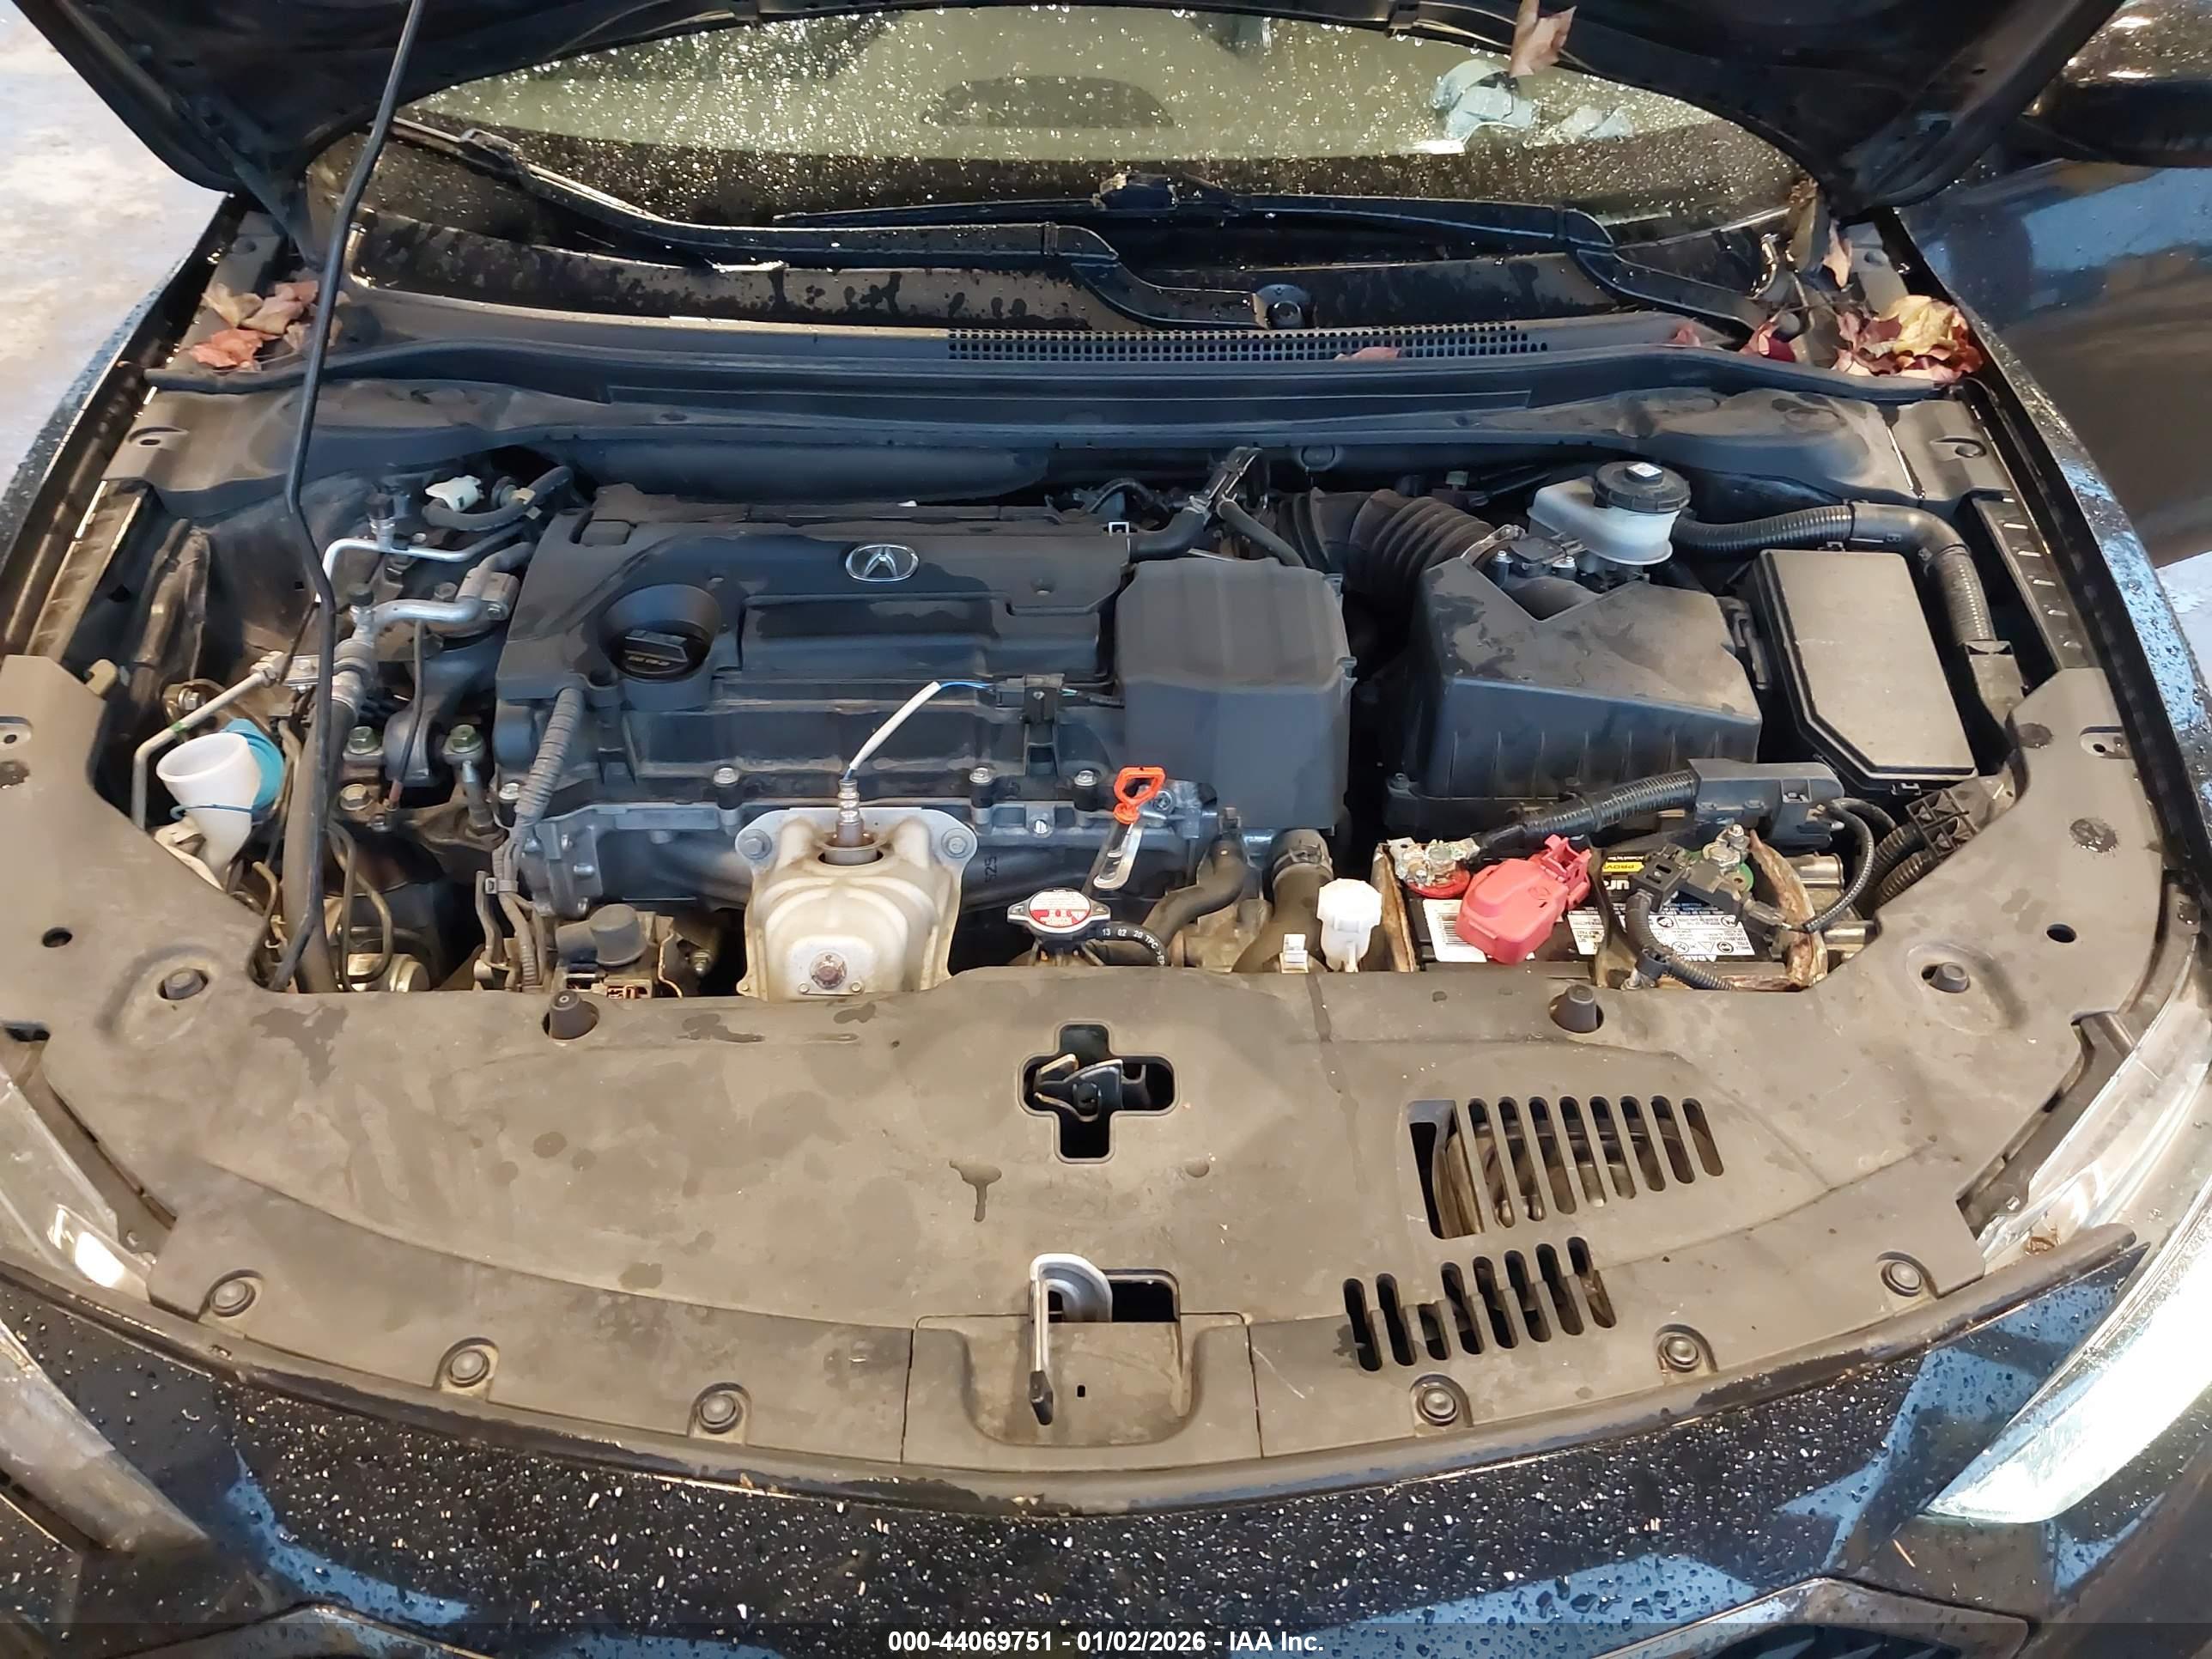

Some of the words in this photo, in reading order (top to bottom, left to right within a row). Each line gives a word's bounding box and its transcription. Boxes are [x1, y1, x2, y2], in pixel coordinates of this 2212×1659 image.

[1102, 927, 1111, 936] 13
[1117, 928, 1127, 937] 02
[1133, 930, 1144, 939] 20
[1145, 934, 1158, 949] TPC
